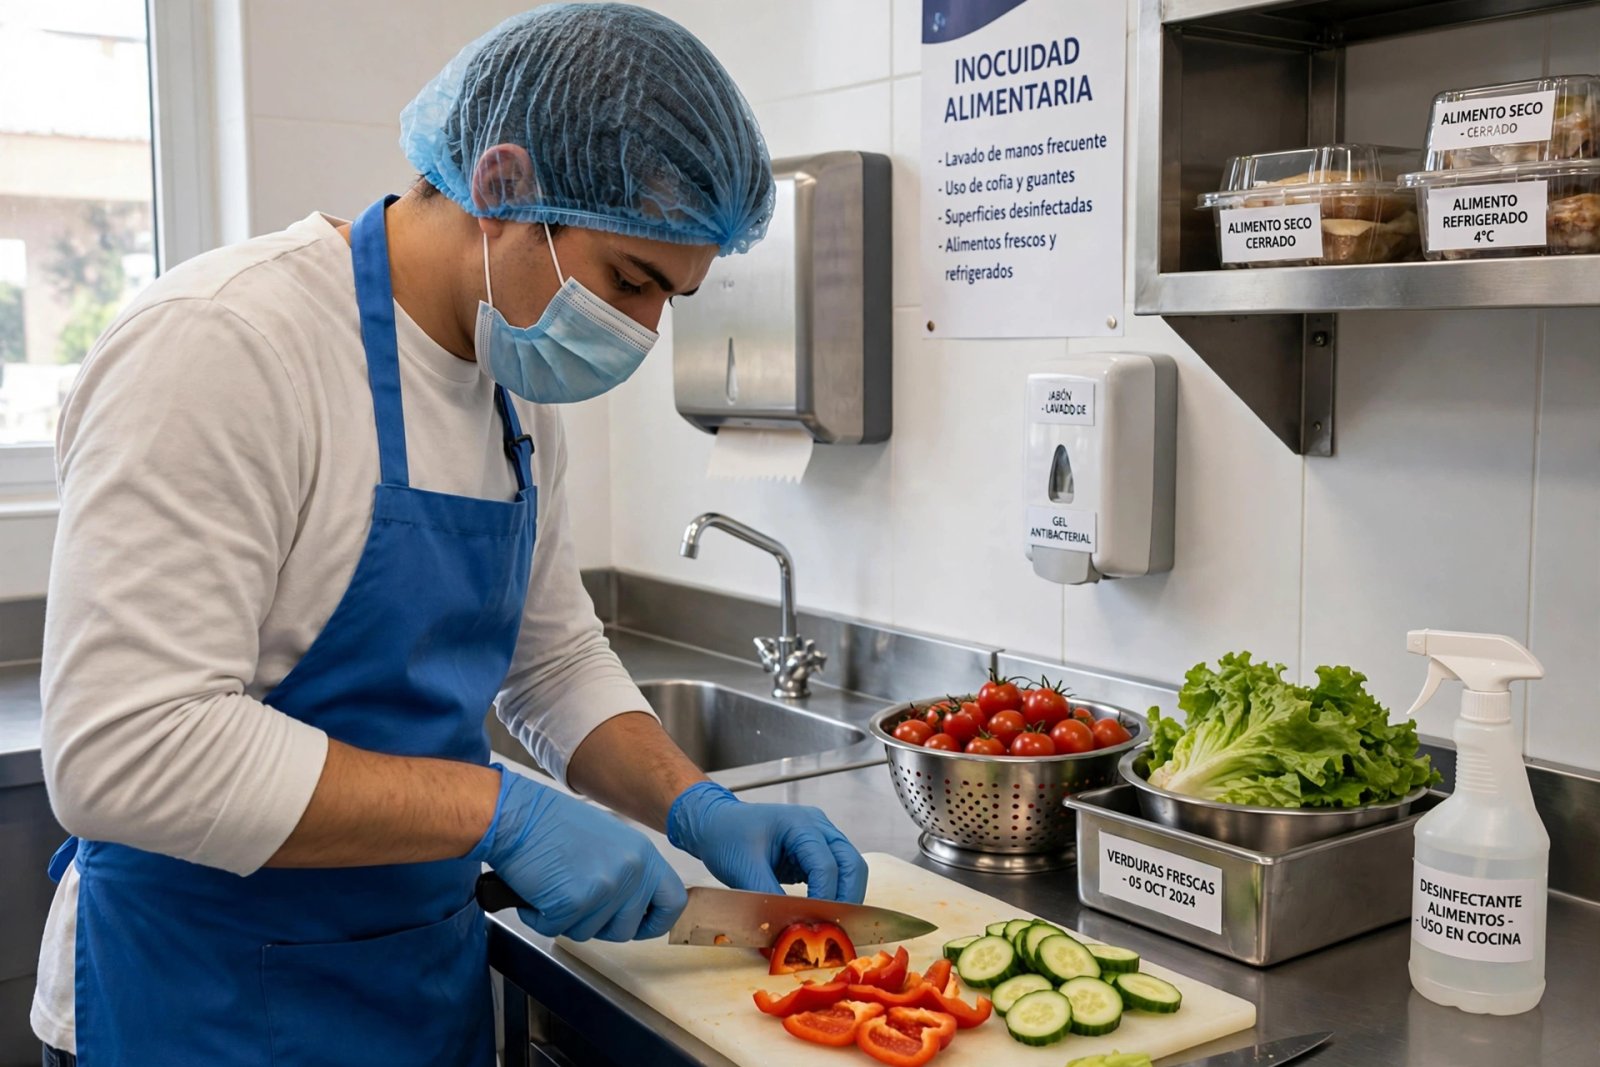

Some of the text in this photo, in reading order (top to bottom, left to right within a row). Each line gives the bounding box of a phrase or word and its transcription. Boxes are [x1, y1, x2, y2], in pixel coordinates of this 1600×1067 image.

[955, 37, 1080, 84] INOCUIDAD
[944, 74, 1093, 123] ALIMENTARIA
[1441, 102, 1543, 125] ALIMENTO SECO
[1467, 123, 1518, 138] CERRADO
[946, 148, 984, 166] Lavado
[988, 145, 1000, 161] de
[1005, 142, 1043, 159] manos
[1047, 134, 1107, 154] frecuente
[946, 180, 966, 195] Uso
[970, 177, 982, 192] de
[986, 174, 1012, 191] cofia
[1016, 176, 1023, 192] y
[1027, 170, 1075, 191] guantes
[945, 205, 1006, 227] Superficies
[1009, 197, 1092, 219] desinfectadas
[1453, 194, 1518, 211] ALIMENTO
[1228, 217, 1312, 234] ALIMENTO SECO
[1443, 211, 1528, 228] REFRIGERADO
[945, 236, 1000, 252] Alimentos
[1004, 232, 1046, 248] frescos
[1050, 234, 1056, 250] y
[1246, 235, 1296, 249] CERRADO
[1474, 230, 1494, 243] 4°C
[946, 263, 1013, 284] refrigerados
[1048, 388, 1072, 400] JABÓN
[1046, 404, 1075, 415] LAVADO
[1077, 405, 1086, 415] DE
[1052, 516, 1067, 527] GEL
[1030, 528, 1091, 544] ANTIBACTERIAL
[1107, 849, 1215, 895] VERDURAS FRESCAS
[1129, 875, 1141, 890] 05
[1144, 881, 1167, 897] OCT
[1169, 888, 1196, 908] 2024
[1420, 879, 1522, 907] DESINFECTANTE
[1428, 902, 1504, 926] ALIMENTOS
[1421, 916, 1442, 935] USO
[1446, 926, 1463, 941] EN
[1467, 931, 1521, 945] COCINA
